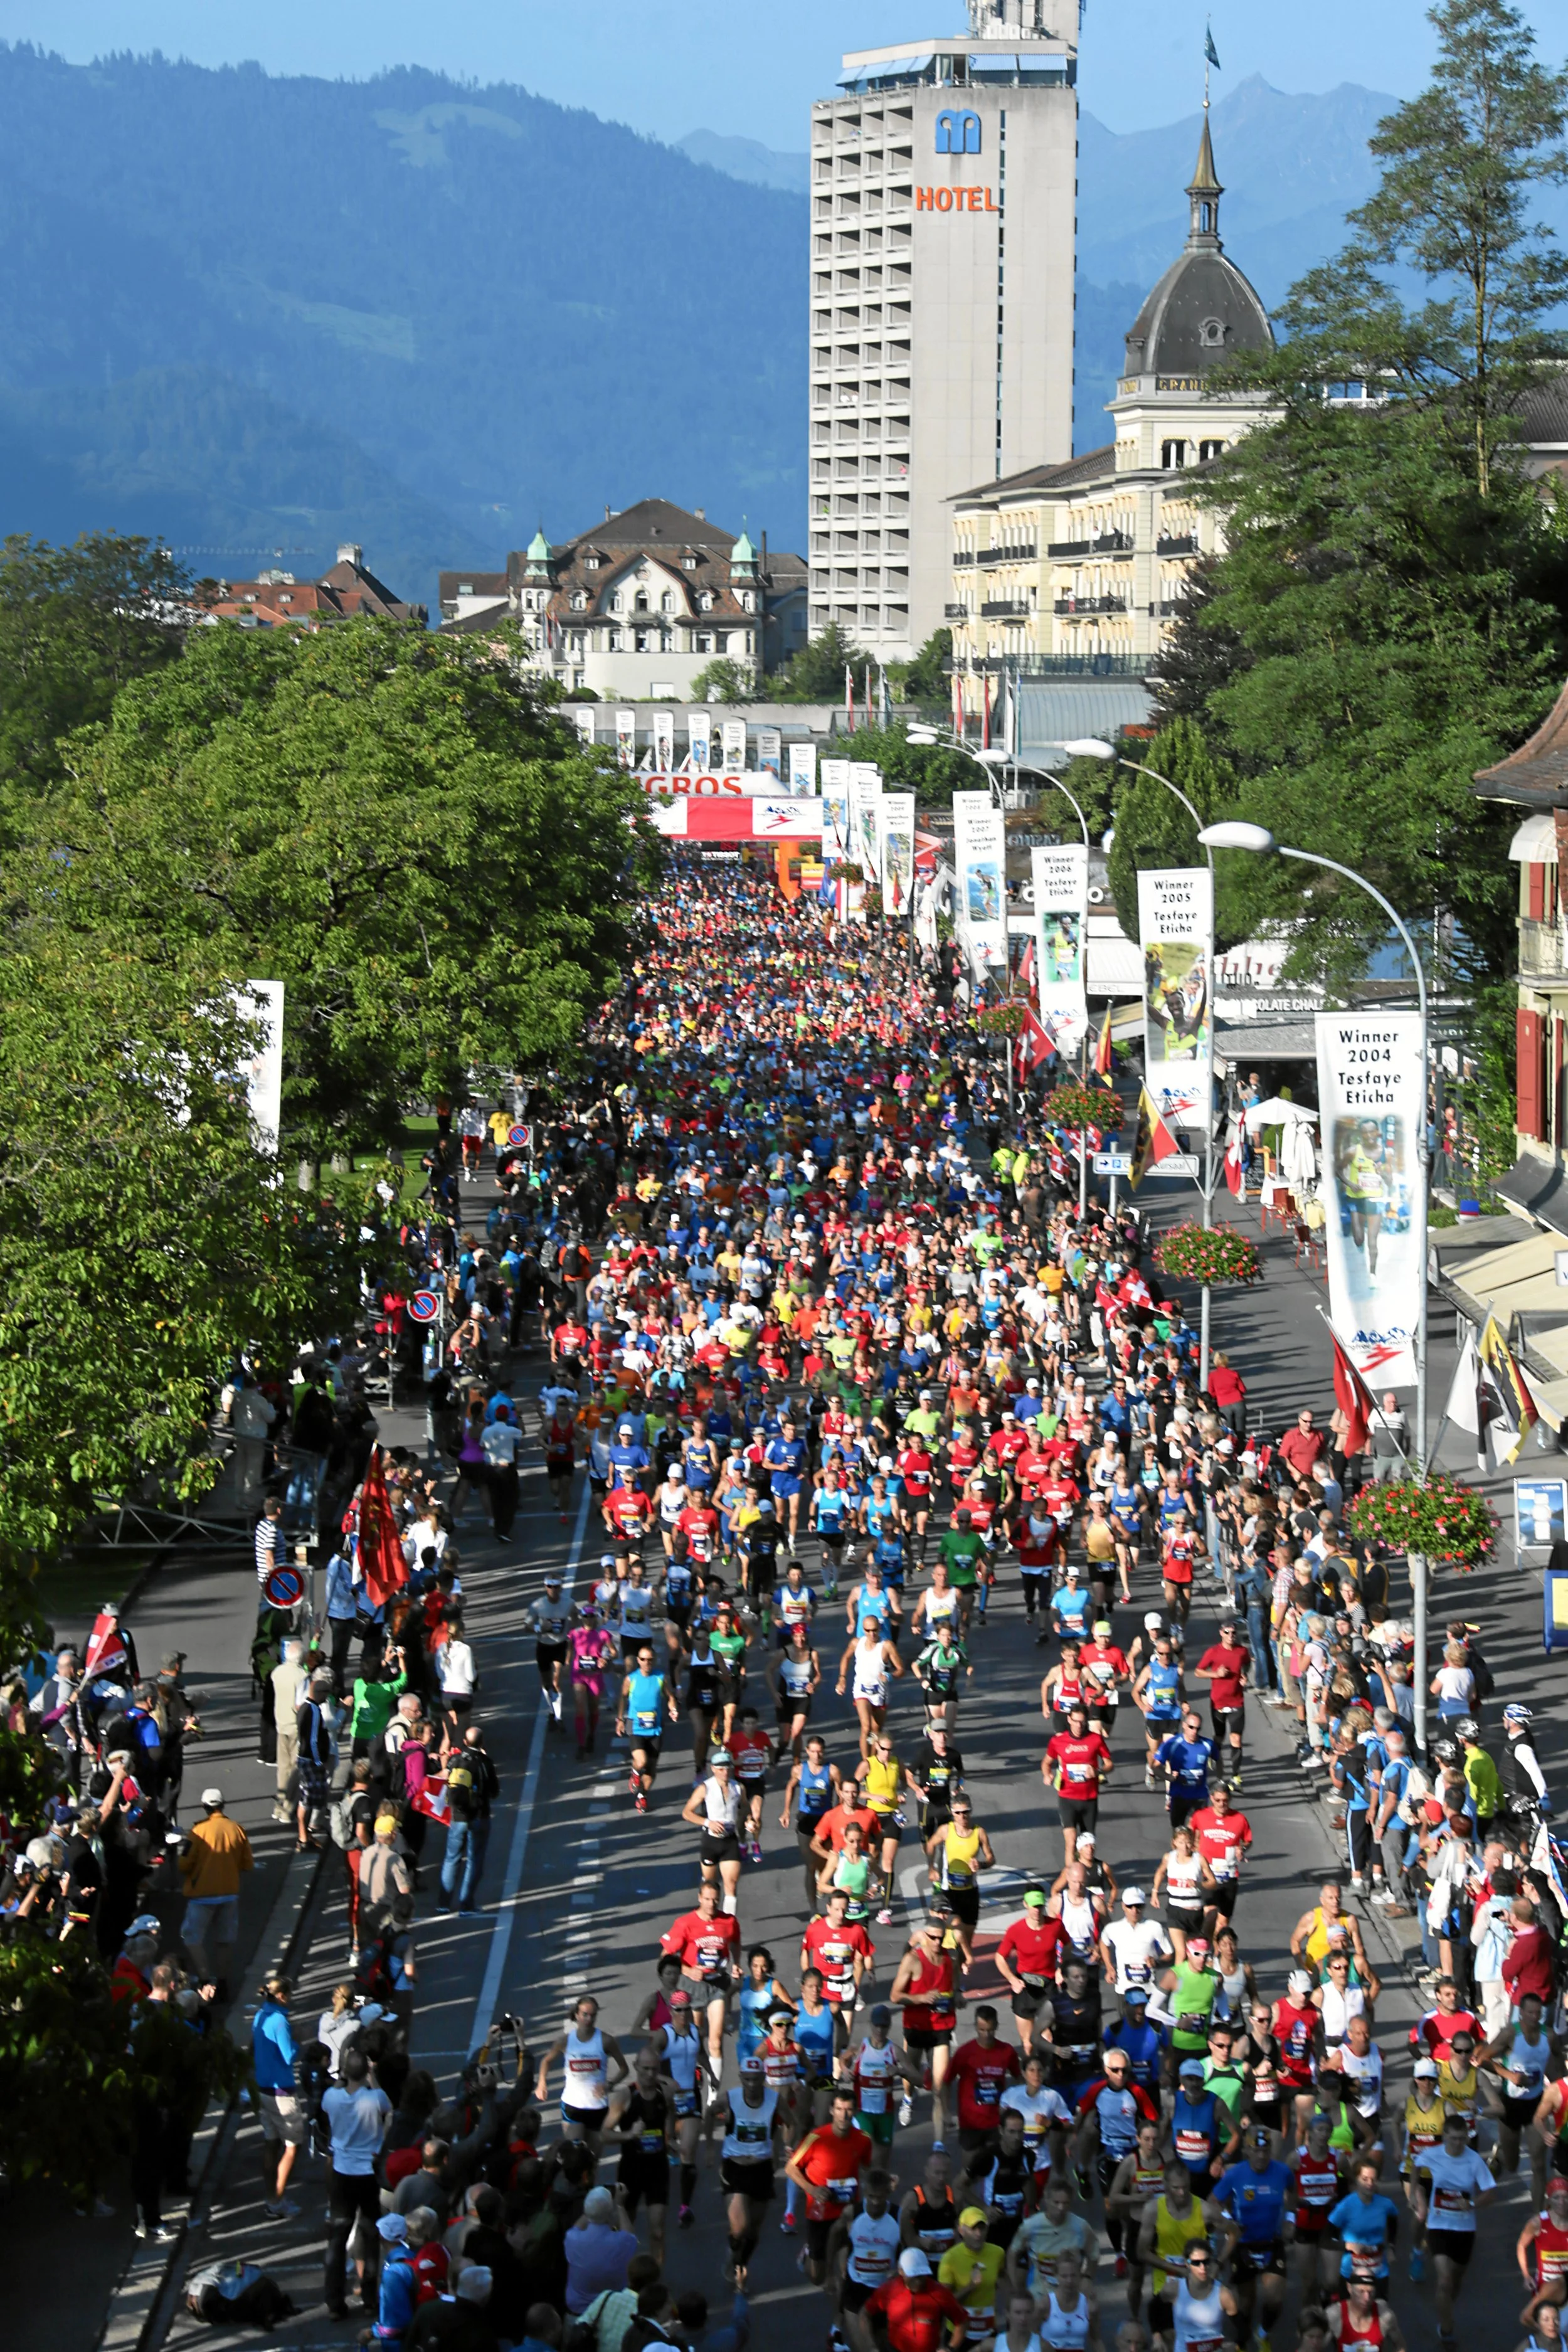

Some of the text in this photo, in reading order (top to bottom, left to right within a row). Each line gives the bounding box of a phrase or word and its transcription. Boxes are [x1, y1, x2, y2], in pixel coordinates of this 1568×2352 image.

[916, 186, 1001, 211] HOTEL
[1049, 866, 1072, 874] 2006
[1044, 879, 1078, 887] Tesfaye
[1154, 880, 1194, 890] Winner
[1049, 888, 1074, 896] Eticha
[1162, 893, 1191, 903] 2005
[1153, 910, 1198, 923] Tesfaye
[1160, 923, 1193, 934] Eticha
[1088, 984, 1125, 992] EBEL
[1339, 1029, 1399, 1043] Winner
[1348, 1049, 1391, 1062] 2004
[1338, 1070, 1402, 1088] Tesfaye
[1346, 1089, 1394, 1104] Eticha
[1413, 2122, 1438, 2133] AUS
